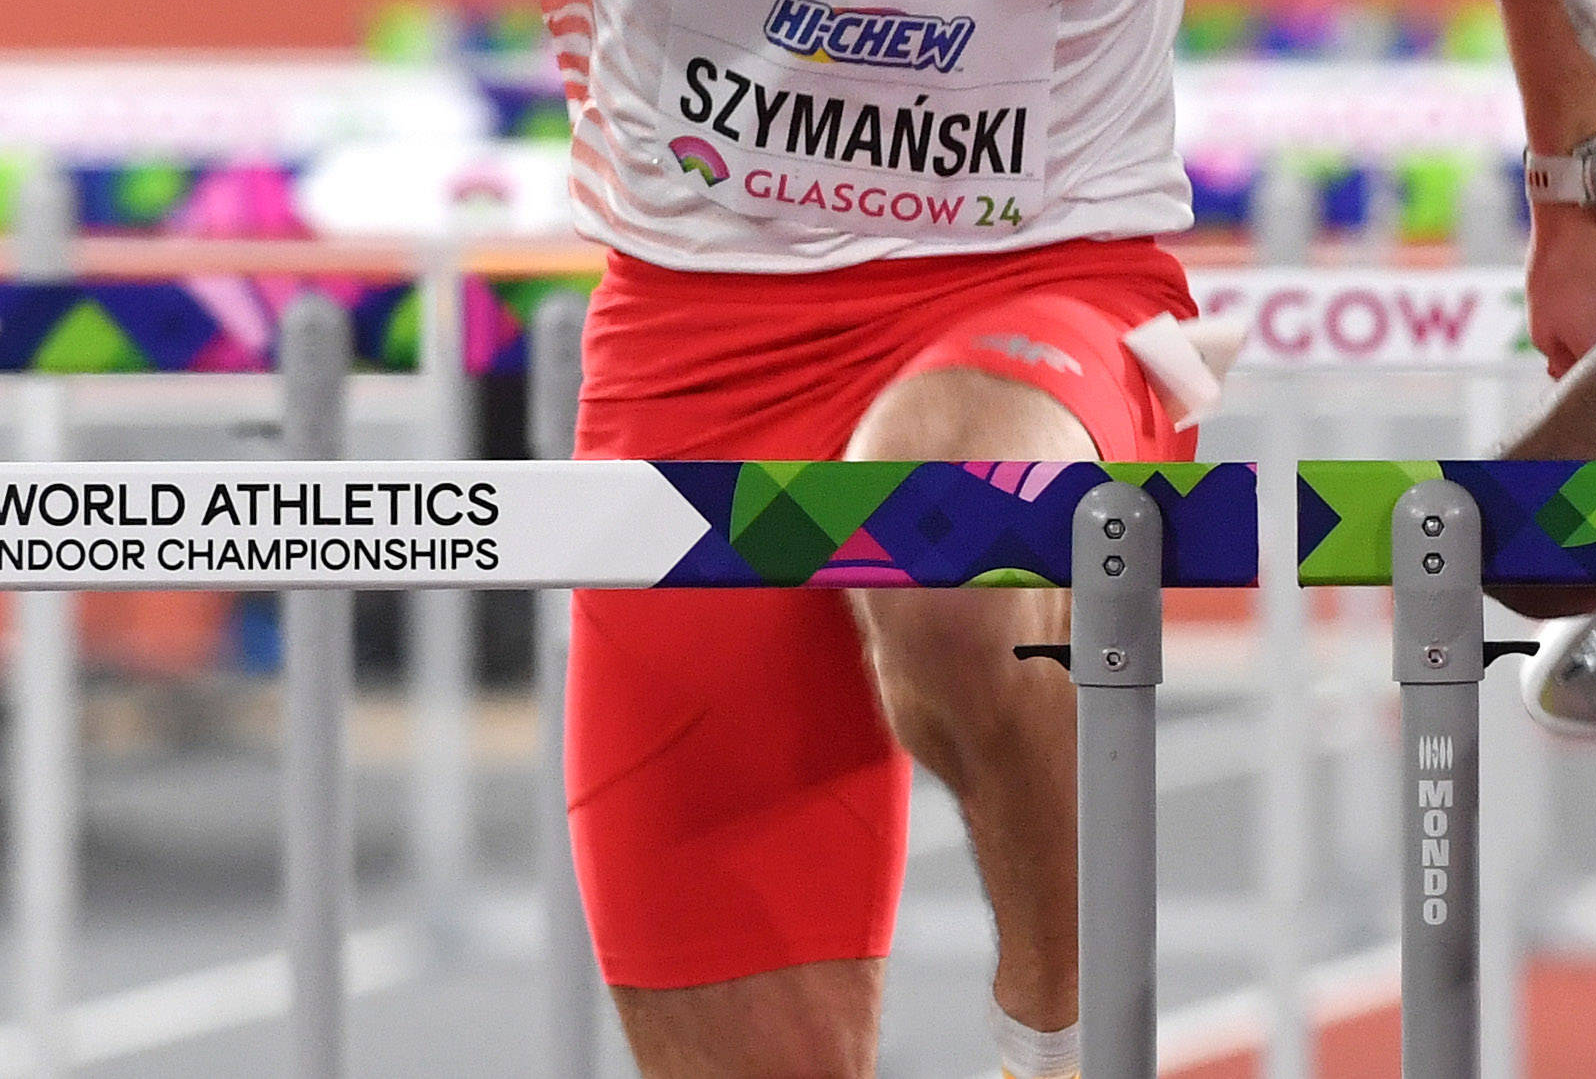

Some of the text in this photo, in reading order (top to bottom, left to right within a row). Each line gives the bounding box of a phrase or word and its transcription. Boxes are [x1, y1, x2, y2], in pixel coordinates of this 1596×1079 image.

[680, 57, 1027, 178] SZYMAŃSKI
[744, 170, 1023, 227] GLASGOW 24
[0, 482, 499, 526] WORLD ATHLETICS
[0, 537, 499, 571] NDOOR CHAMPIONSHIPS
[1418, 780, 1453, 925] MONDO
